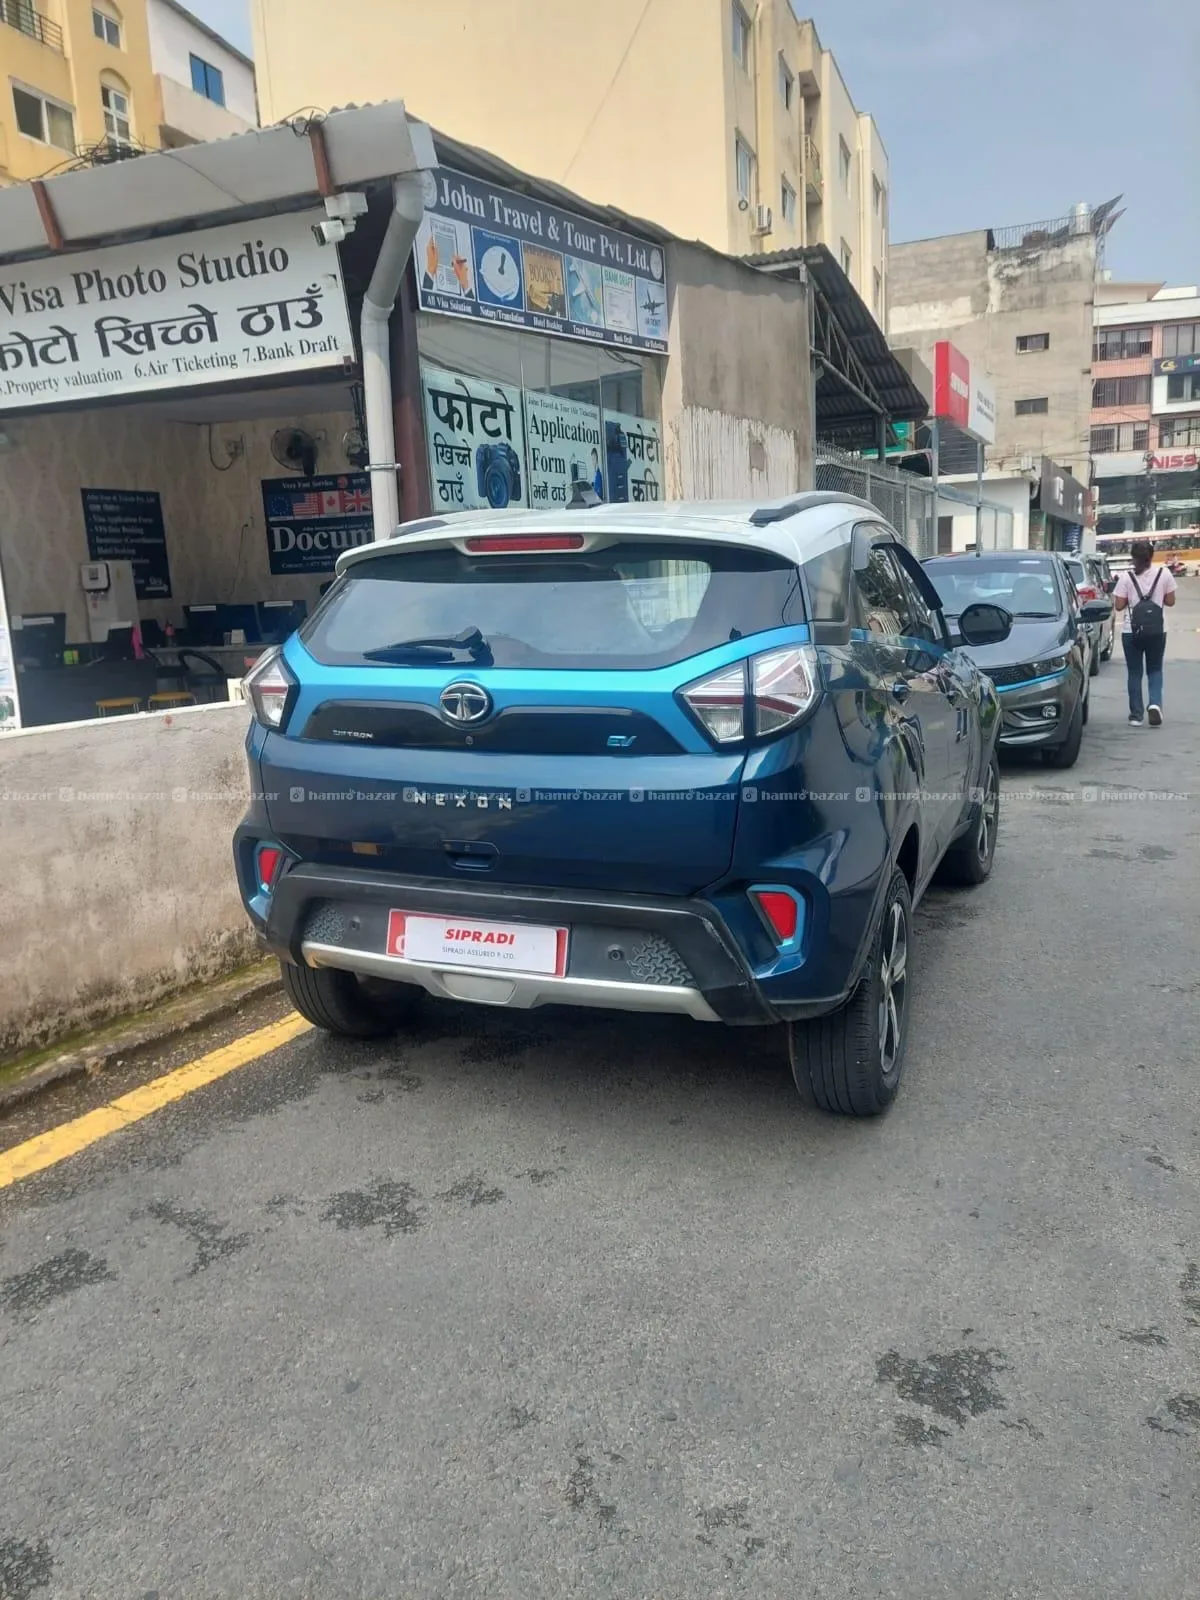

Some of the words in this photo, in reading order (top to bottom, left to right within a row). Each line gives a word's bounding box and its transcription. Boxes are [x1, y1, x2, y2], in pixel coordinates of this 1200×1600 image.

[440, 178, 486, 218] John
[489, 194, 543, 237] Travel
[547, 216, 561, 242] &
[563, 221, 596, 254] Tour
[599, 234, 624, 264] Pvt.
[627, 244, 650, 272] Ltd.
[0, 281, 64, 317] Visa
[71, 264, 167, 306] Photo
[177, 240, 290, 290] Studio
[95, 303, 218, 359] खिच्ने
[236, 283, 323, 337] ठाउँ
[0, 377, 59, 396] .Property
[64, 367, 123, 387] valuation
[134, 359, 169, 379] 6.Air
[175, 351, 239, 376] Ticketing
[242, 340, 296, 365] 7.Bank
[300, 335, 339, 357] Draft
[427, 378, 516, 442] फोटो
[530, 411, 600, 445] Application
[626, 424, 660, 464] फोटो
[531, 448, 566, 474] Form
[436, 472, 464, 503] ठाउँ
[606, 735, 637, 748] EV
[413, 792, 512, 810] NEXON
[442, 946, 466, 956] SIPRADI
[467, 948, 496, 958] ASSURED
[445, 928, 516, 946] SIPRADI
